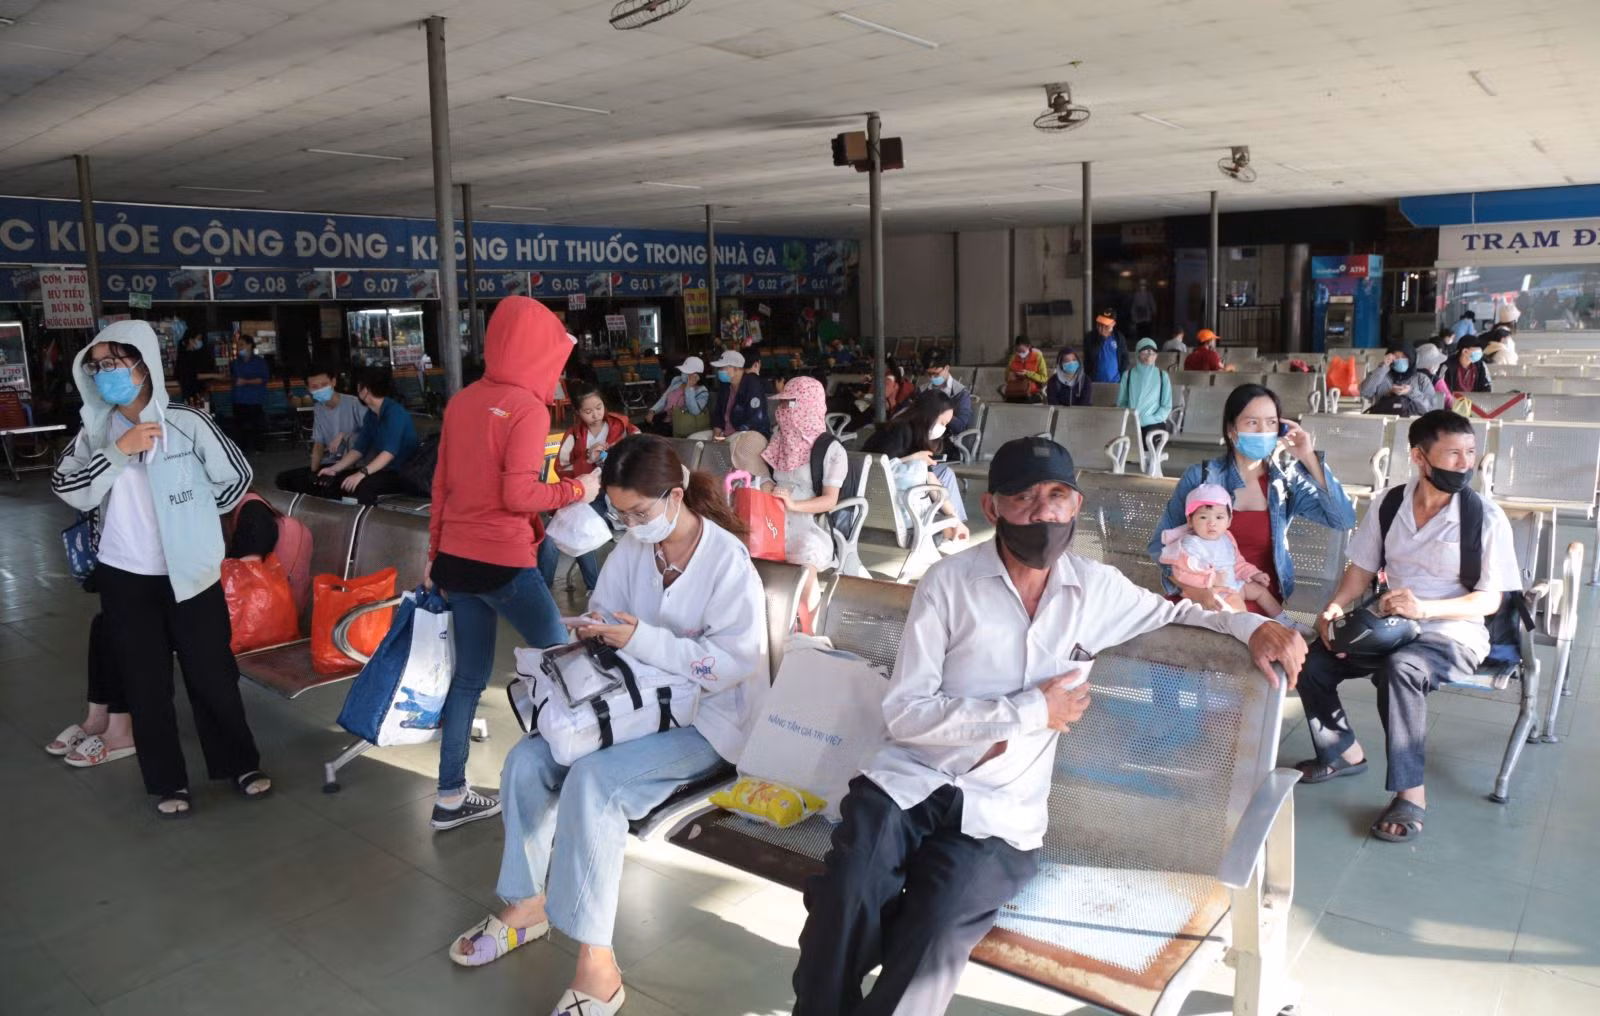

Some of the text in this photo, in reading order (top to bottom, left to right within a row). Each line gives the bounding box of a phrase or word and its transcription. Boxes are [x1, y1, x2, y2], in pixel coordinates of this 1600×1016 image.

[172, 220, 284, 263] CỘNG
[294, 218, 388, 260] ĐỒNG
[516, 233, 558, 262] HÚT
[565, 233, 638, 263] THUỐC
[644, 243, 707, 265] TRONG
[713, 241, 748, 265] NHÀ
[753, 247, 776, 265] GA
[1462, 228, 1600, 254] TRẠM Đ
[1349, 265, 1366, 273] ATM
[107, 275, 157, 292] G.09
[245, 277, 286, 293] G.08
[364, 279, 398, 293] G.07
[552, 279, 580, 292] G.05
[169, 490, 194, 505] PLLOTE
